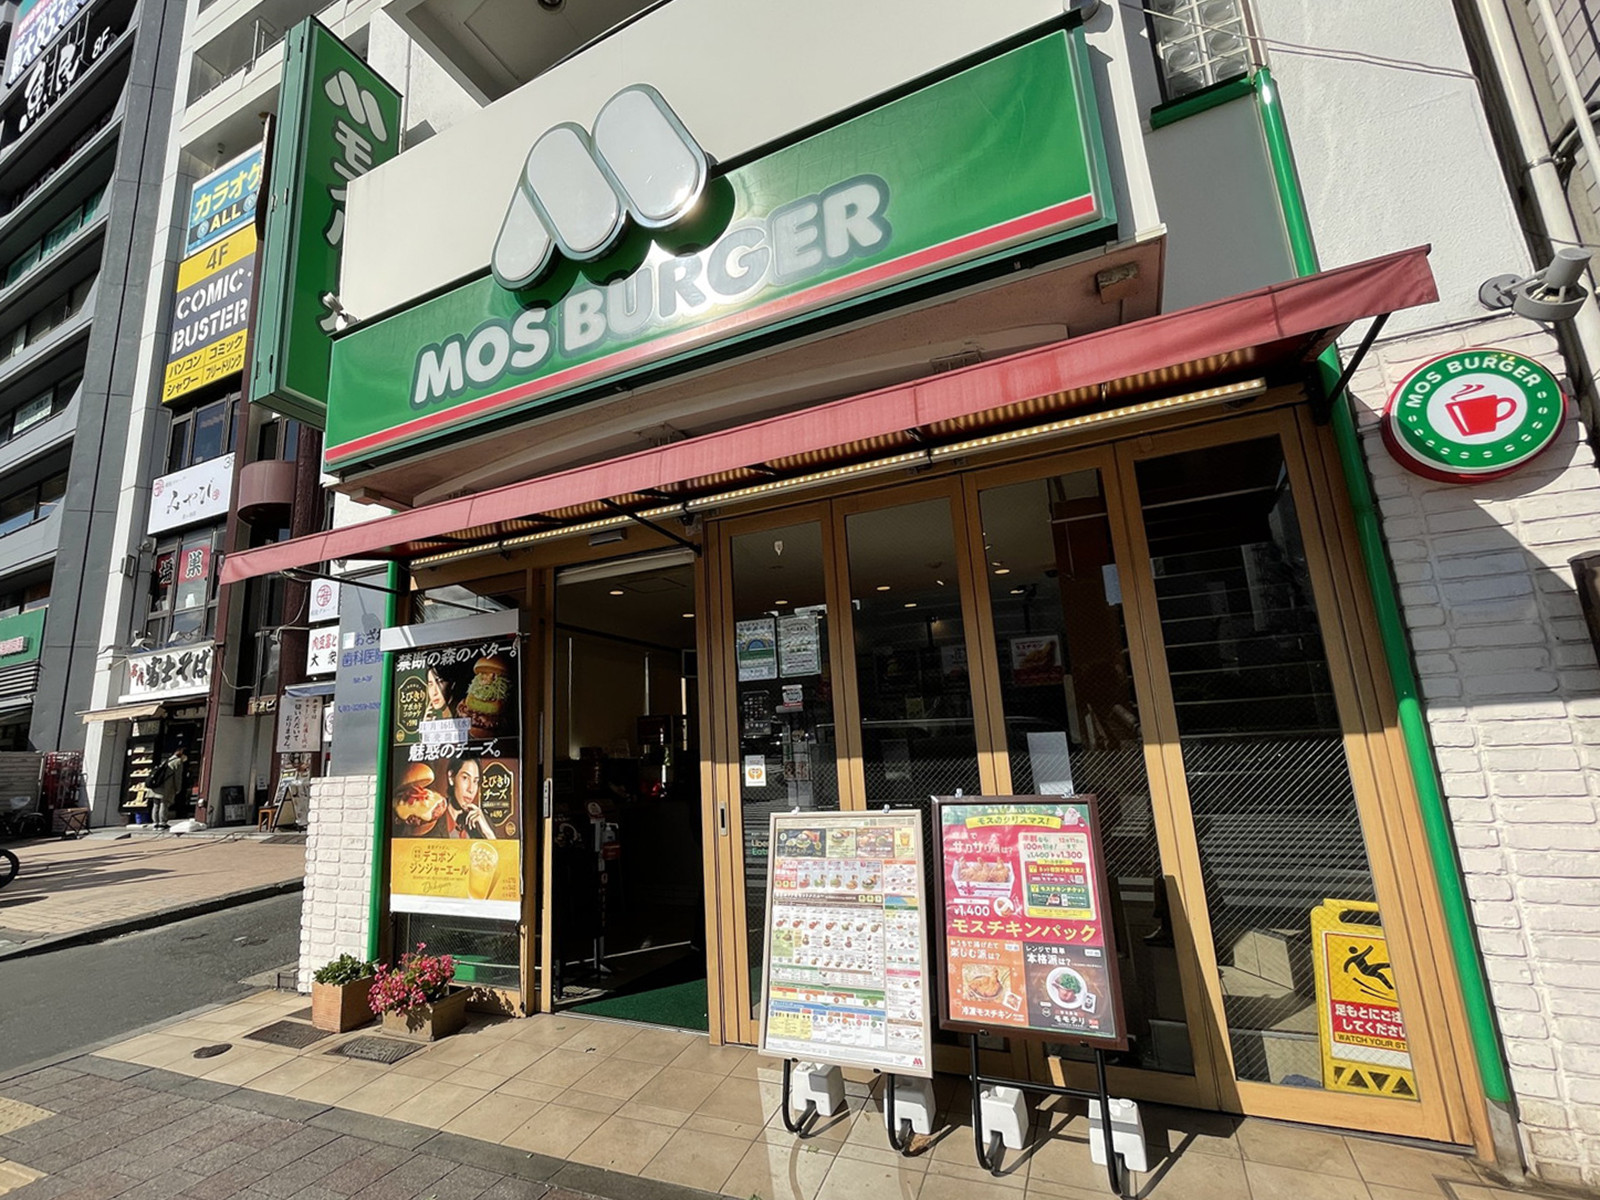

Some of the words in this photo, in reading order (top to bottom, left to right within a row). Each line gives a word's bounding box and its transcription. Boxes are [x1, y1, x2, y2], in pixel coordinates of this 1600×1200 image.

[194, 163, 262, 221] カラオケ
[209, 205, 241, 233] ALL
[206, 243, 229, 270] 4F
[413, 307, 552, 406] MOS
[562, 183, 887, 354] BURGER
[171, 298, 248, 354] BUSTER
[209, 336, 243, 360] コミック
[168, 355, 202, 378] パソコン
[167, 376, 199, 397] シャワー
[1405, 371, 1442, 408] MOS
[1446, 356, 1542, 387] BURGER
[146, 646, 211, 688] 富士そば
[408, 738, 501, 762] 魅惑のチーズ。
[482, 774, 511, 788] とびきり
[483, 788, 508, 801] チーズ
[409, 863, 469, 876] ジンジャーエール
[952, 919, 1097, 943] モスチキンパック
[1027, 953, 1071, 966] 本格派は?
[1335, 1004, 1403, 1023] 足もとにご注
[1337, 1033, 1368, 1044] WATCH
[1369, 1037, 1394, 1047] YOUR
